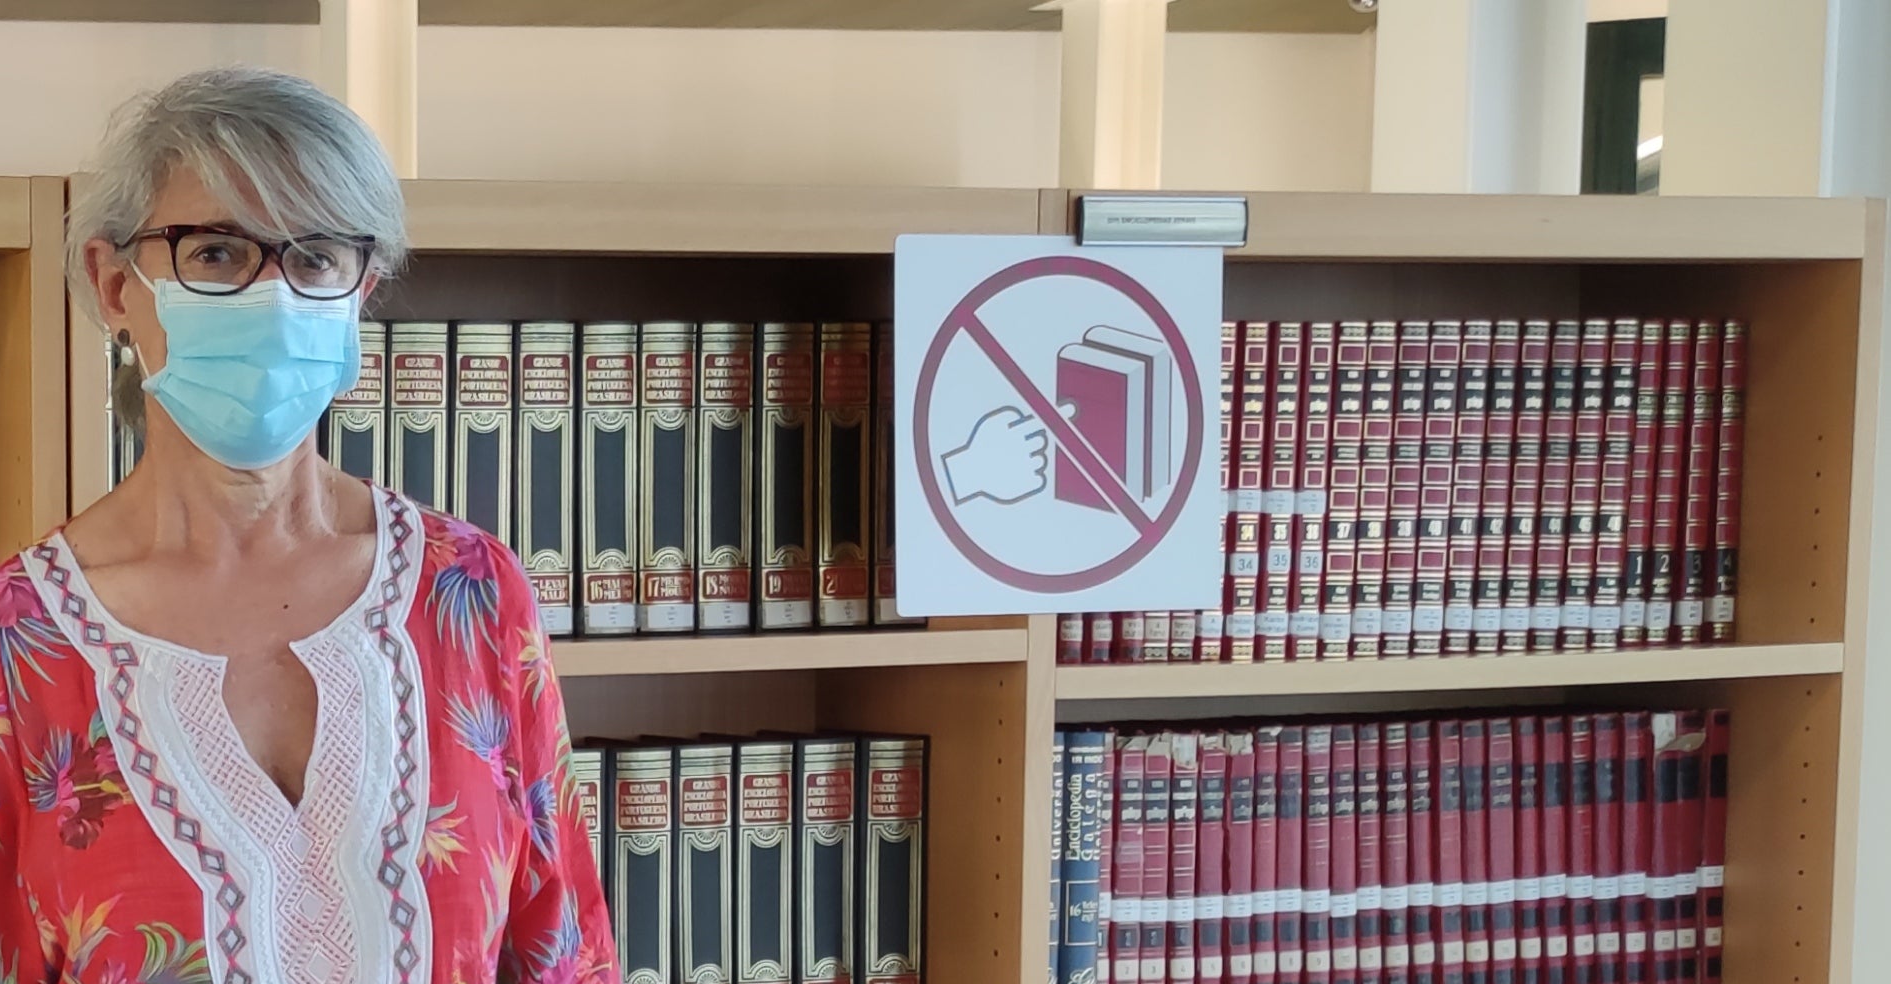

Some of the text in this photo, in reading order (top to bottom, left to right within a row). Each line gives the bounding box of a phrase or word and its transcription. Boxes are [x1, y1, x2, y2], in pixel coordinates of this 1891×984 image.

[1238, 559, 1253, 570] 34
[1272, 554, 1287, 567] 35
[1304, 556, 1318, 568] 36
[1661, 555, 1669, 572] 2
